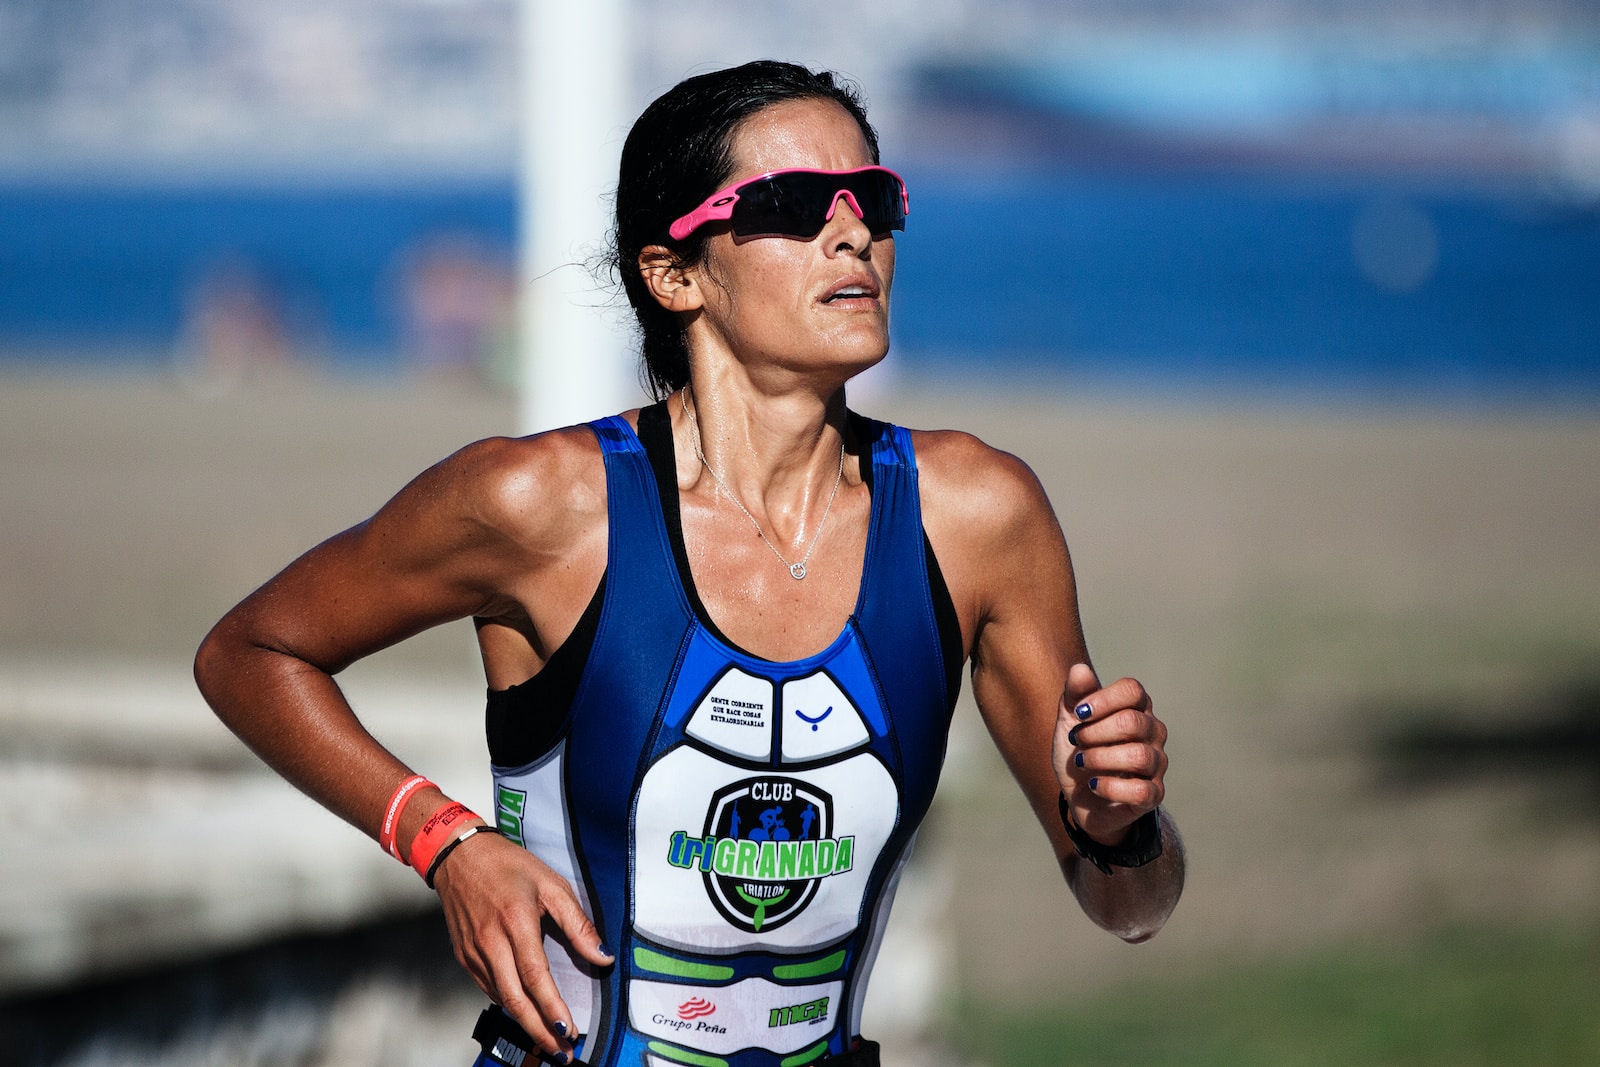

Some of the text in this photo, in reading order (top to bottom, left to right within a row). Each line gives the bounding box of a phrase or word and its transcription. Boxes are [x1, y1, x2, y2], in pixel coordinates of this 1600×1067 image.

[711, 697, 763, 710] GENTE CORRIENTE
[711, 715, 765, 727] EXTRAORDINARIAS
[752, 782, 793, 801] CLUB
[668, 831, 855, 881] triGRANADA
[652, 1014, 727, 1034] Grupo Peña
